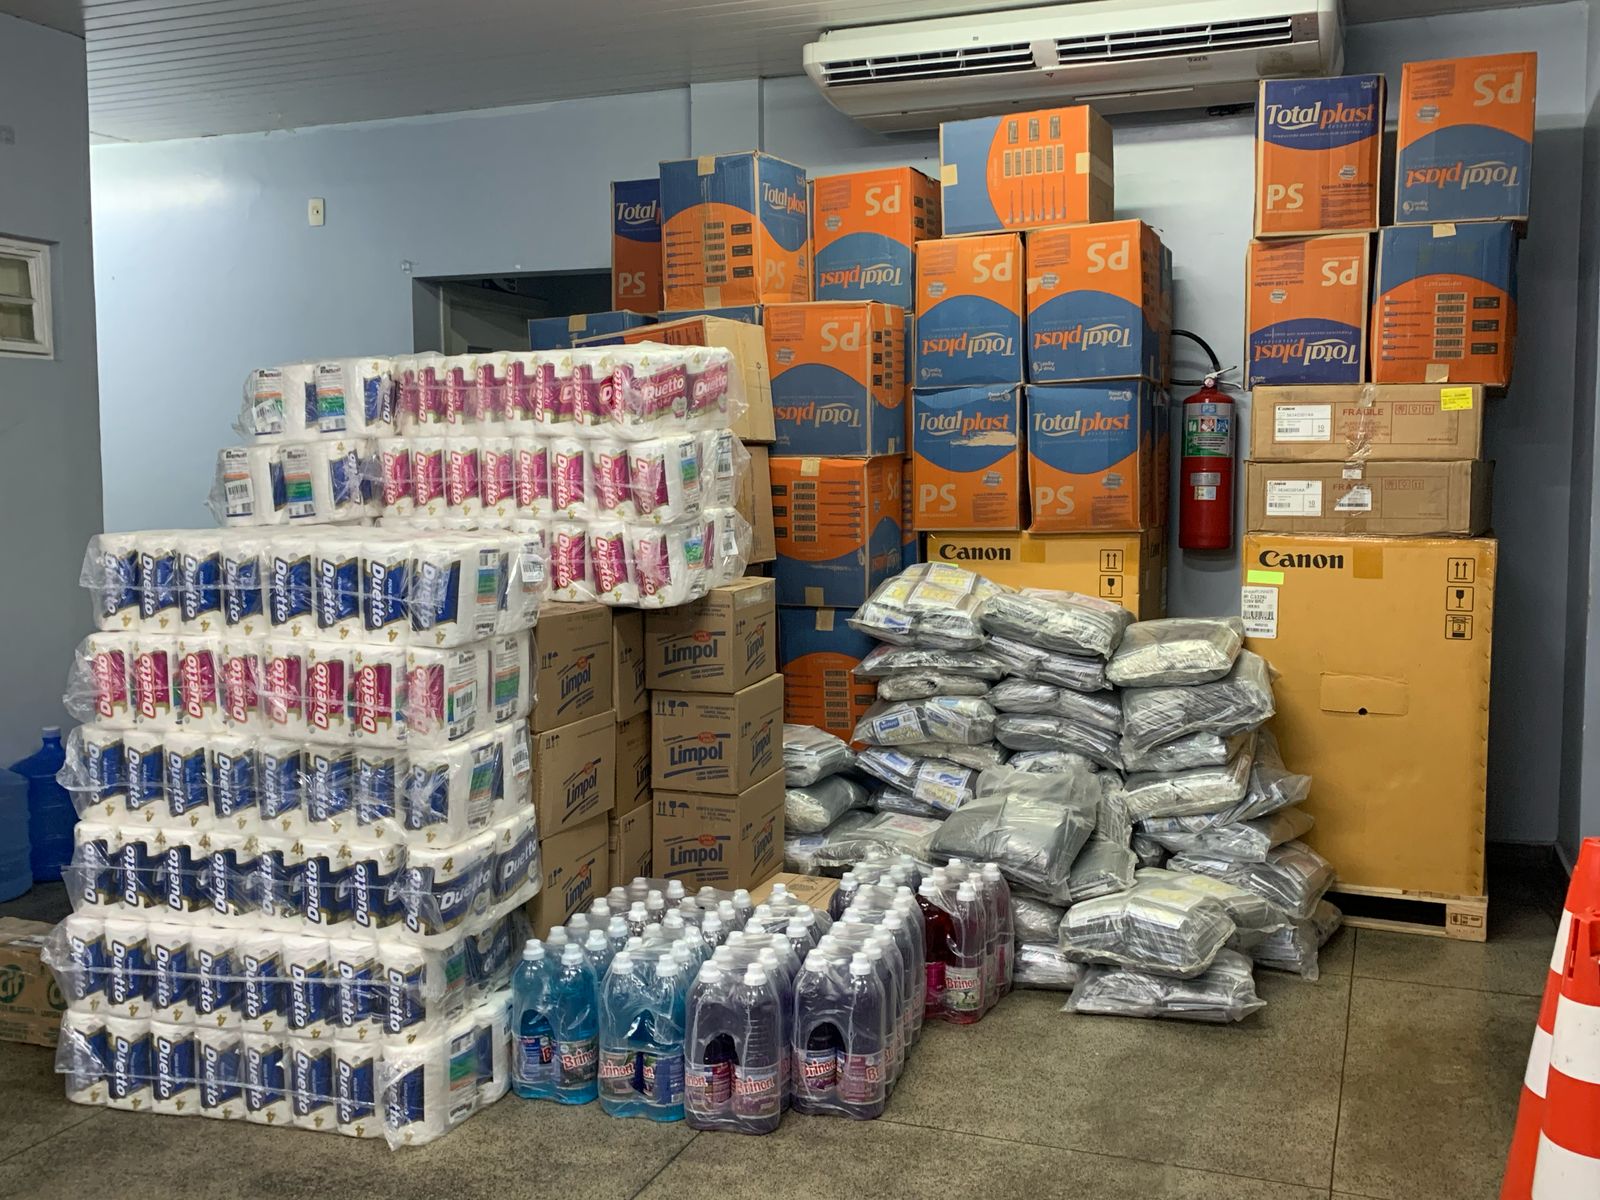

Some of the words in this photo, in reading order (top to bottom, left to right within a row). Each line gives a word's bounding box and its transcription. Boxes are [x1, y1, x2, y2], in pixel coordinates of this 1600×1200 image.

[1473, 71, 1523, 107] PS
[865, 187, 901, 216] PS
[1266, 183, 1304, 209] PS
[619, 272, 645, 297] PS
[766, 258, 785, 289] PS
[973, 251, 1013, 284] PS
[1087, 240, 1130, 274] PS
[1322, 260, 1360, 286] PS
[820, 323, 859, 352] PS
[419, 370, 427, 422] Duetto
[447, 370, 455, 424] Duetto
[505, 364, 514, 419] Duetto
[535, 365, 544, 422] Duetto
[573, 366, 584, 425] Duetto
[614, 365, 624, 425] Duetto
[642, 376, 684, 400] Duetto
[695, 375, 727, 397] Duetto
[383, 452, 395, 505] Duetto
[416, 452, 428, 505] Duetto
[451, 452, 463, 505] Duetto
[486, 452, 498, 505] Duetto
[520, 451, 532, 506] Duetto
[557, 453, 568, 509] Duetto
[600, 454, 616, 509] Duetto
[920, 484, 957, 512] PS
[1036, 486, 1075, 515] PS
[558, 533, 570, 589] Duetto
[596, 537, 614, 594] Duetto
[940, 544, 1011, 560] Canon
[1260, 550, 1344, 569] Canon
[142, 553, 155, 617] Duetto
[183, 555, 199, 619] Duetto
[225, 558, 240, 623] Duetto
[274, 558, 289, 623] Duetto
[321, 559, 336, 627] Duetto
[370, 560, 386, 628] Duetto
[419, 561, 436, 629] Duetto
[664, 639, 717, 665] Limpol
[747, 636, 764, 661] Limpol
[98, 653, 112, 718] Duetto
[140, 653, 156, 718] Duetto
[186, 653, 203, 718] Duetto
[230, 657, 248, 723] Duetto
[272, 658, 288, 724] Duetto
[312, 662, 329, 730] Duetto
[361, 665, 376, 734] Duetto
[561, 667, 591, 699] Limpol
[670, 742, 722, 766] Limpol
[752, 731, 771, 761] Limpol
[128, 748, 141, 809] Duetto
[169, 752, 185, 816] Duetto
[217, 753, 233, 817] Duetto
[264, 754, 277, 818] Duetto
[567, 769, 596, 808] Limpol
[503, 829, 511, 843] 4
[504, 839, 536, 879] Duetto
[670, 844, 722, 866] Limpol
[754, 832, 773, 861] Limpol
[84, 843, 98, 903] Duetto
[125, 844, 138, 906] Duetto
[169, 848, 183, 910] Duetto
[214, 851, 228, 914] Duetto
[263, 853, 275, 915] Duetto
[307, 859, 321, 924] Duetto
[440, 870, 491, 911] Duetto
[442, 858, 453, 872] 4
[566, 875, 592, 912] Limpol
[356, 862, 370, 928] Duetto
[406, 868, 422, 933] Duetto
[113, 941, 126, 1003] Duetto
[156, 945, 169, 1007] Duetto
[199, 951, 213, 1013] Duetto
[245, 956, 258, 1018] Duetto
[291, 964, 307, 1028] Duetto
[339, 961, 354, 1027] Duetto
[388, 969, 403, 1033] Duetto
[115, 1037, 129, 1098] Duetto
[158, 1037, 172, 1098] Duetto
[204, 1044, 218, 1107] Duetto
[248, 1047, 262, 1111] Duetto
[296, 1052, 311, 1115] Duetto
[338, 1059, 351, 1123] Duetto
[735, 1076, 774, 1095] Brinort
